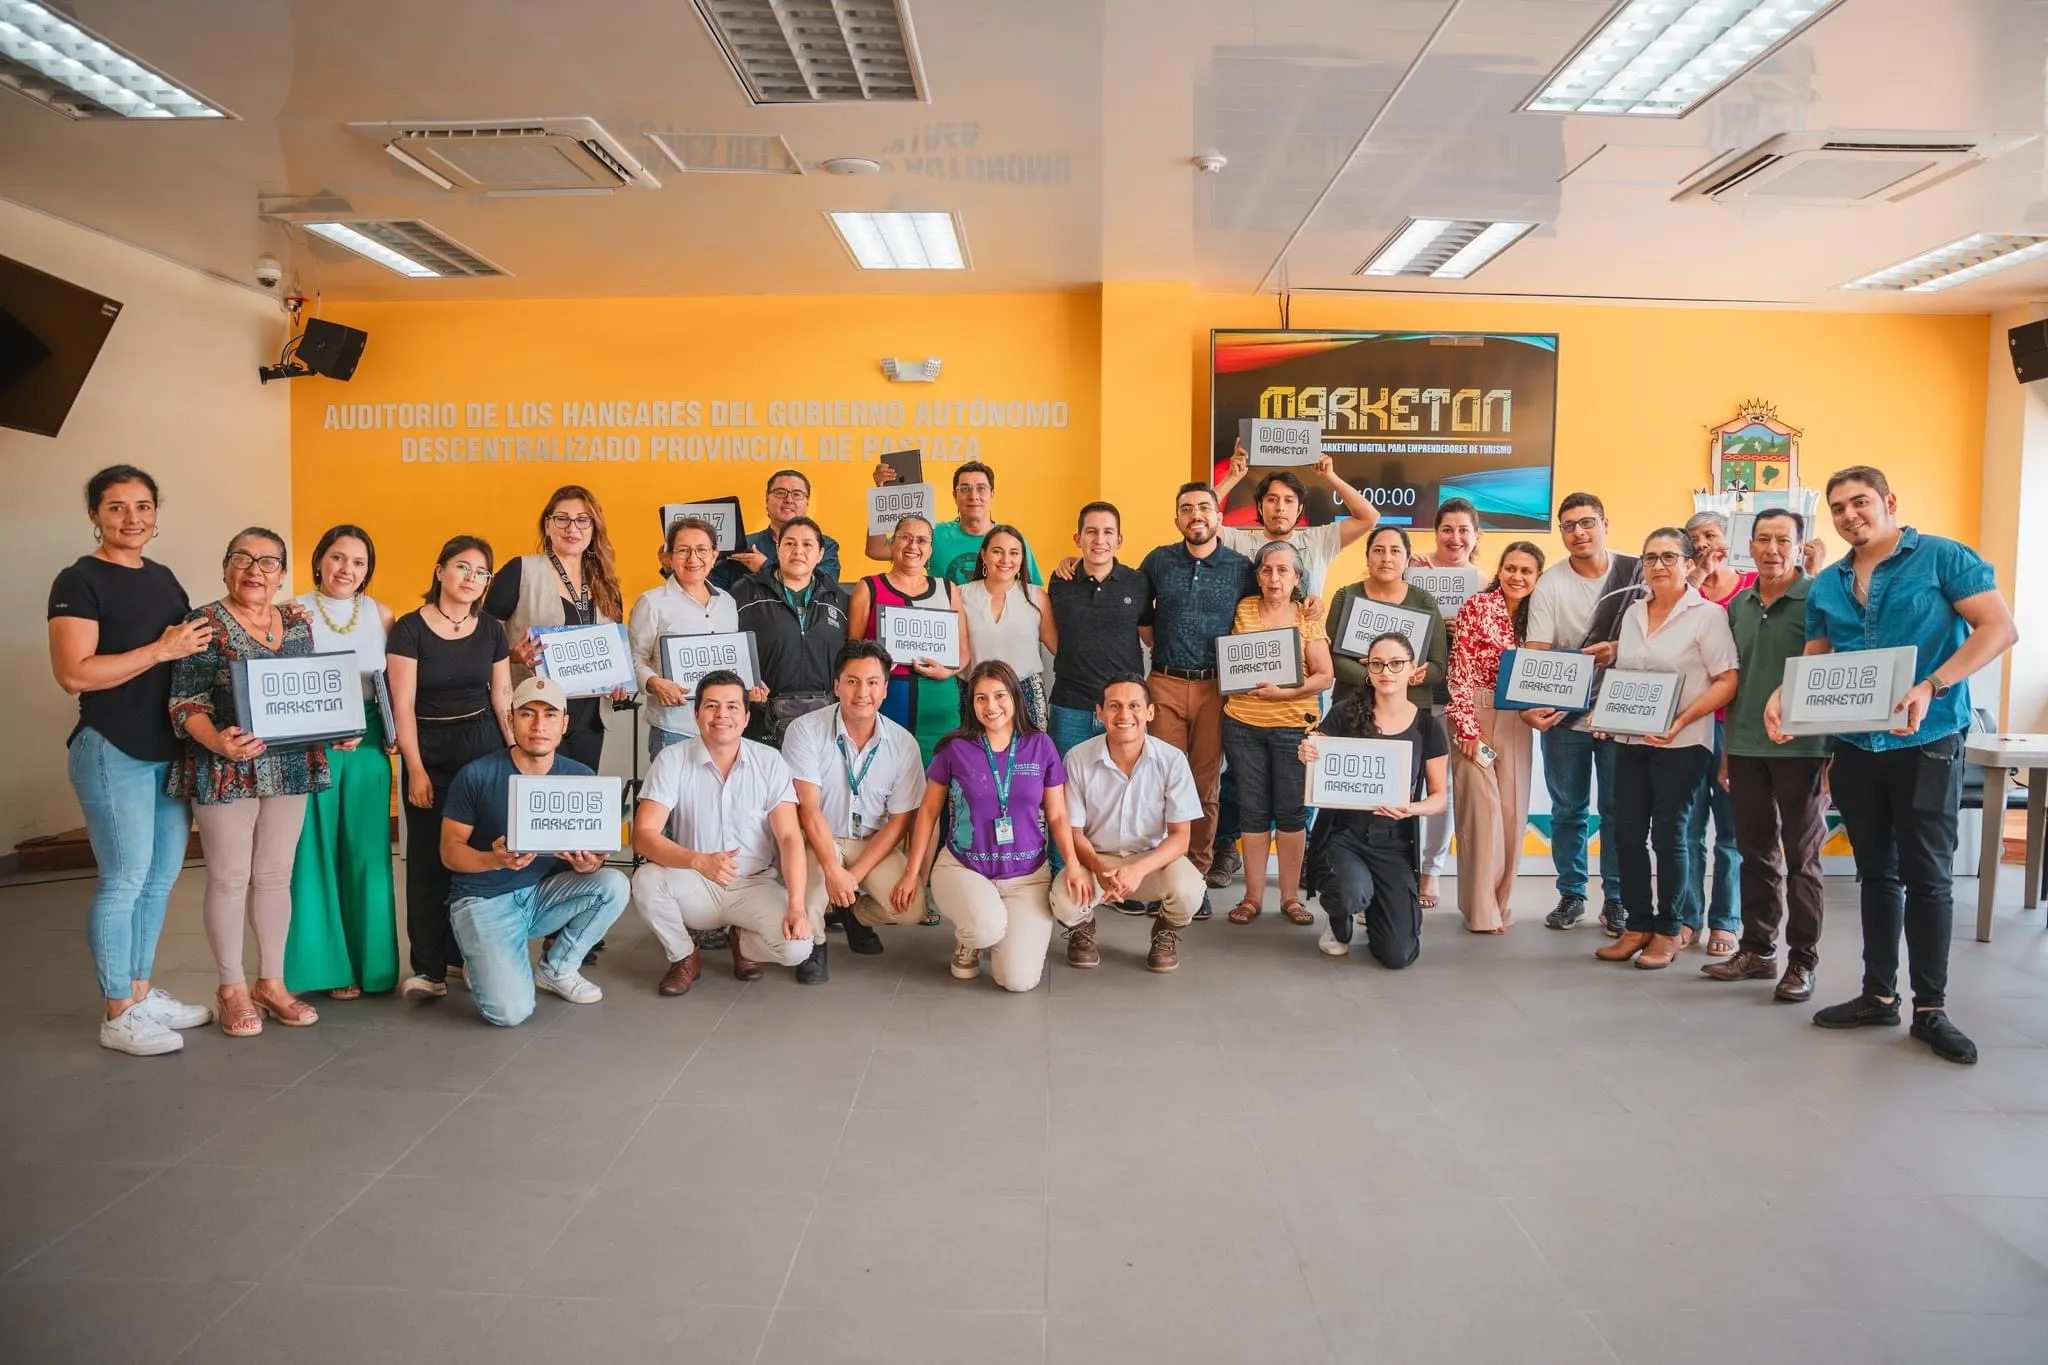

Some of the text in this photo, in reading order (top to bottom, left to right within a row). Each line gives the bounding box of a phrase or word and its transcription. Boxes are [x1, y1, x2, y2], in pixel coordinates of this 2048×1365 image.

[324, 394, 1069, 430] AUDITORIO DE LOS HANGARES DEL GOBIERNO AUTÓNOMO
[1259, 387, 1512, 432] MARKETON
[1260, 427, 1310, 444] 0004
[401, 435, 640, 463] DESCENTRALIZADO
[649, 435, 813, 463] PROVINCIAL
[818, 435, 855, 462] DE
[1260, 445, 1308, 455] MARKETON
[1320, 443, 1512, 455] ARKETING DIGITAL PARA EMPRENDEDORES DE TURISMO
[875, 491, 924, 511] 0007
[1412, 576, 1465, 592] 0002
[894, 617, 946, 639] 0010
[1358, 609, 1414, 638] 0015
[552, 637, 609, 663] 0008
[895, 639, 946, 653] MARKETON
[1227, 640, 1281, 662] 0003
[679, 645, 737, 668] 0016
[558, 659, 612, 677] MARKETON
[1229, 660, 1282, 675] MARKETON
[1522, 658, 1578, 682] 0014
[1808, 665, 1878, 690] 0012
[262, 669, 342, 696] 0006
[1519, 680, 1573, 695] MARKETON
[1609, 681, 1663, 702] 0009
[266, 698, 343, 715] MARKETON
[1605, 702, 1656, 716] MARKETON
[1806, 693, 1873, 706] MARKETON
[1324, 753, 1386, 779] 0011
[1324, 780, 1384, 794] MARKETON
[530, 791, 603, 813] 0005
[531, 818, 602, 830] MARKETON
